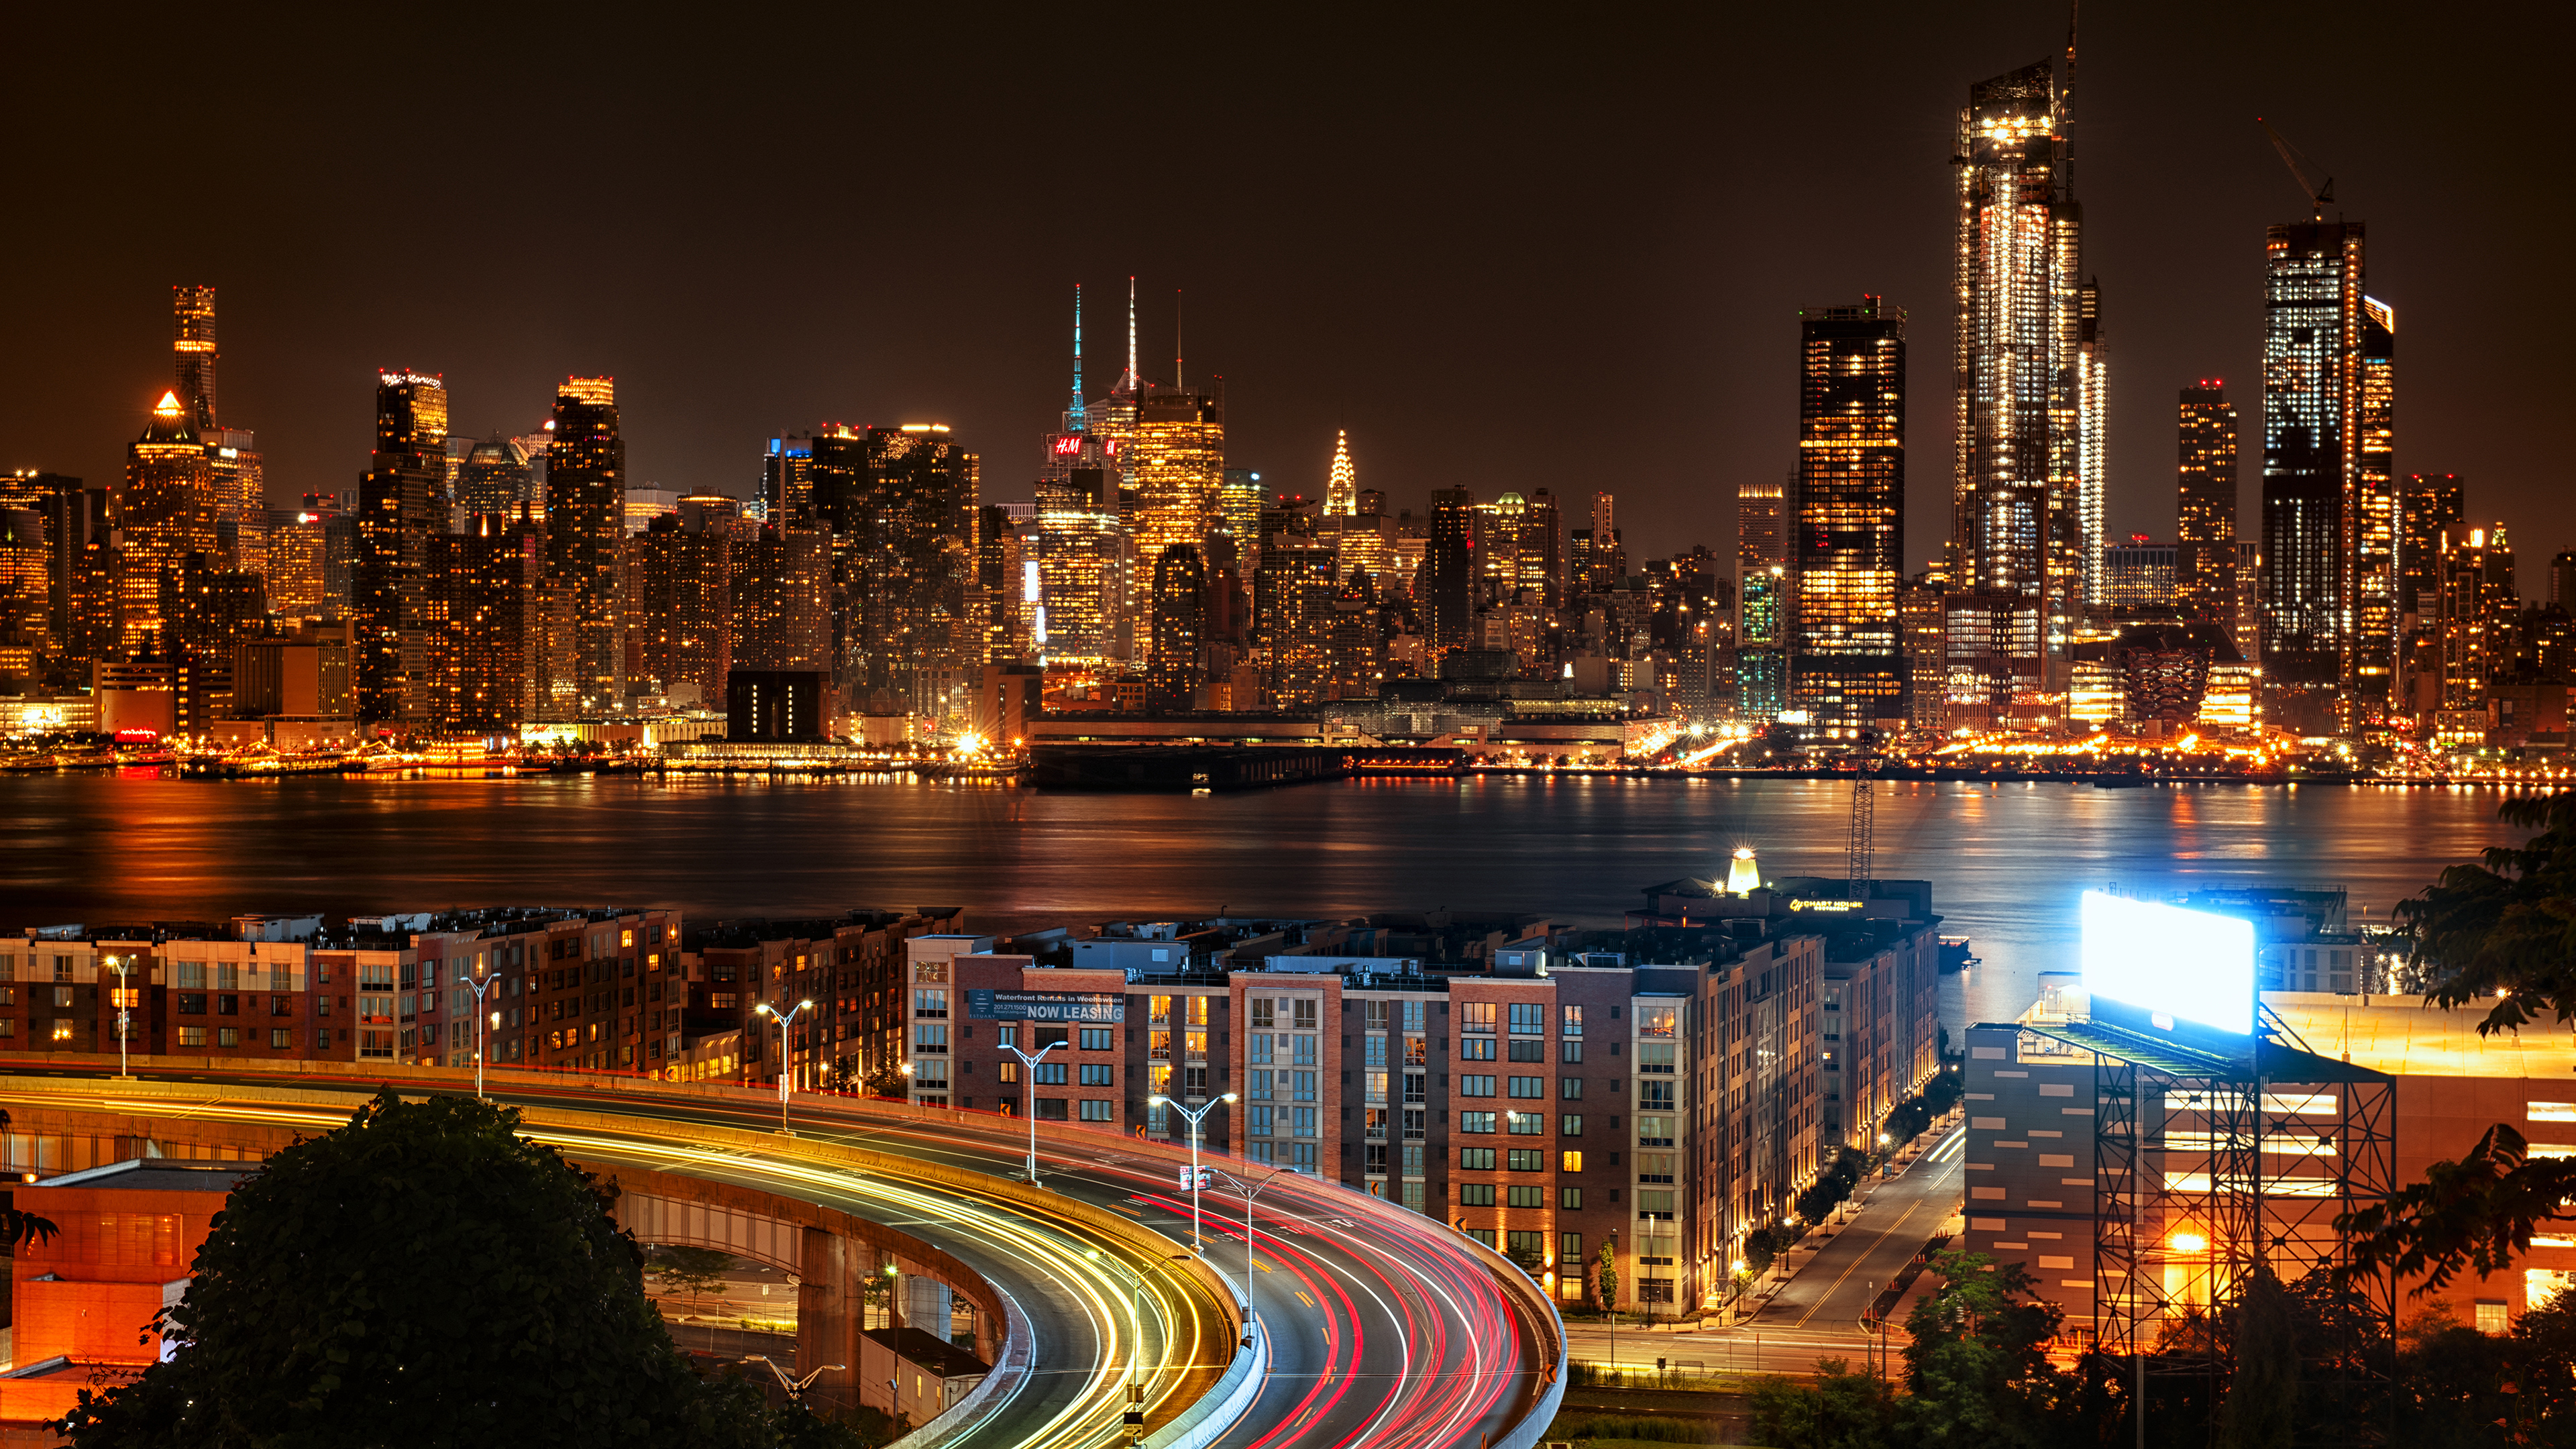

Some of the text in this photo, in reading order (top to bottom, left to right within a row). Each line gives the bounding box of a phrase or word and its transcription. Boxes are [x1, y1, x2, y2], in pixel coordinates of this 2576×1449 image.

[1056, 438, 1080, 453] H&M
[1077, 996, 1123, 1004] Weehawken
[1028, 1006, 1122, 1020] NOW LEASING
